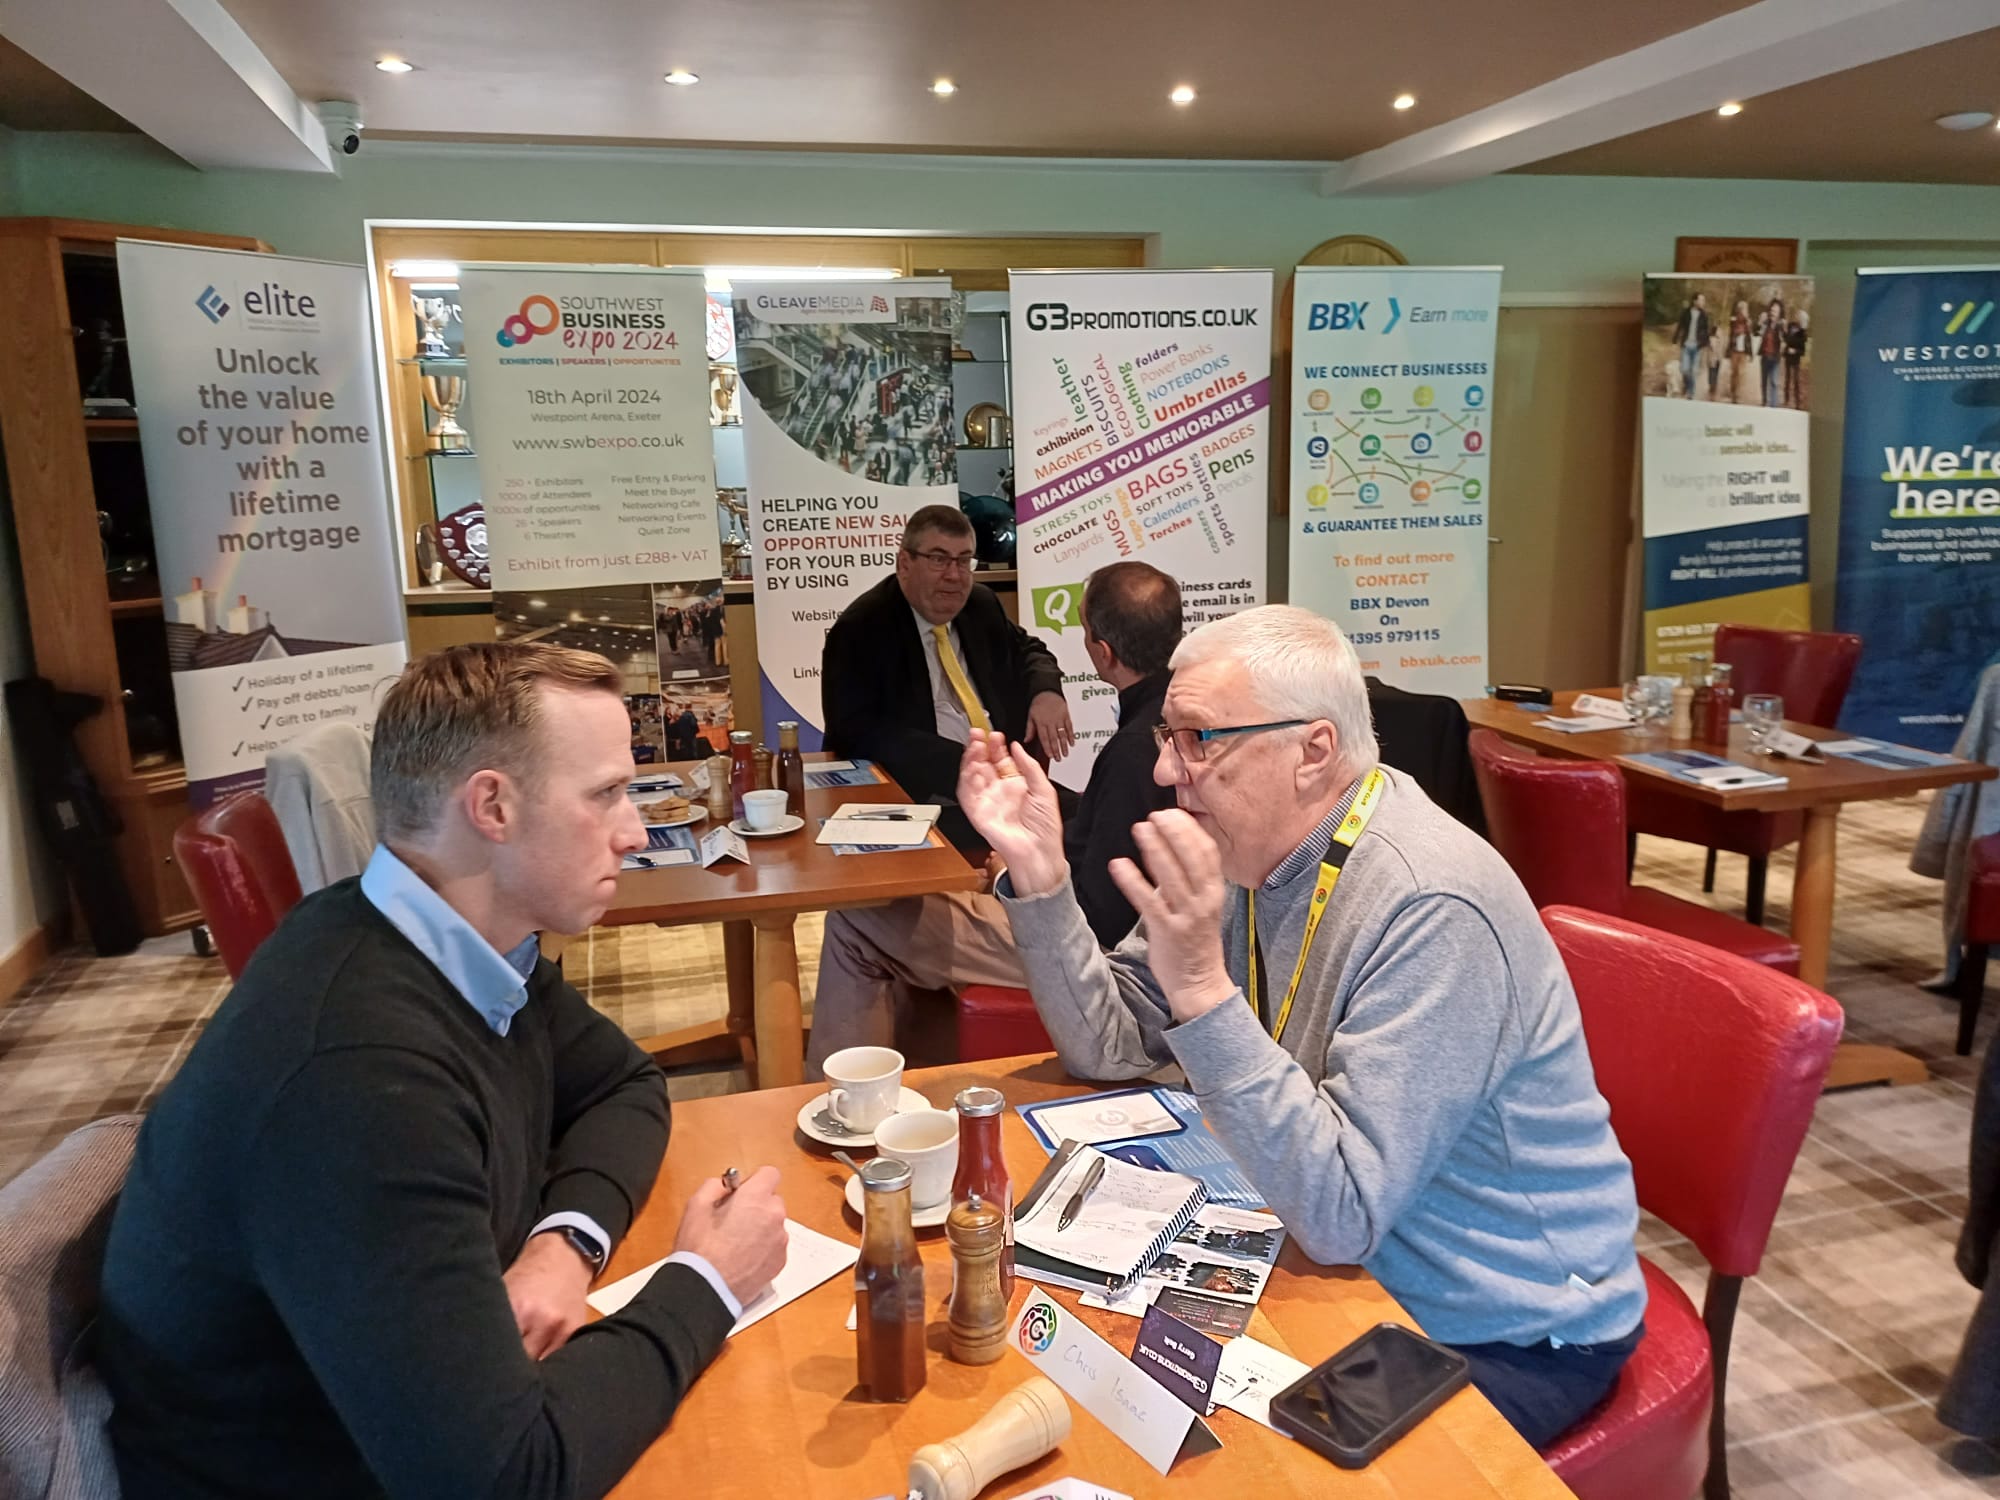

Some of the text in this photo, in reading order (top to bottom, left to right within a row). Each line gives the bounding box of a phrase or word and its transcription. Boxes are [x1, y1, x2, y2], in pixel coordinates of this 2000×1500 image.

[244, 282, 316, 318] elite
[560, 296, 663, 311] SOUTHWEST
[562, 313, 666, 329] BUSINESS
[1308, 302, 1370, 331] BBX
[1410, 307, 1489, 323] Earn more
[563, 329, 679, 356] expo 2024
[216, 348, 320, 376] Unlock
[500, 358, 681, 366] EXHIBITORS SPEAKERS OPPORTUNITIES
[1135, 342, 1179, 368] folders
[1140, 344, 1214, 385] Power Banks
[1146, 354, 1230, 401] NOTEBOOKS
[1304, 363, 1488, 378] WE CONNECT BUSINESSES
[199, 384, 335, 410] the value
[527, 389, 662, 406] 18th April 2024
[1052, 357, 1088, 422] leather
[1093, 353, 1135, 439] ECOLOGICAL
[1117, 361, 1151, 430] Clothing
[1154, 370, 1248, 422] Umbrellas
[531, 412, 662, 423] Westpoint Arena, Exeter
[1081, 374, 1119, 446] BISCUITS
[177, 420, 371, 450] of your home
[512, 433, 684, 450] www.swbexpo.co.uk
[1036, 424, 1095, 457] exhibition
[1201, 423, 1256, 458] BADGES
[1031, 394, 1256, 511] MAKING YOU MEMORABLE
[1034, 438, 1103, 480] MAGNETS
[236, 455, 326, 481] with a
[1208, 448, 1255, 480] Pens
[535, 477, 584, 487] Exhibitors
[611, 473, 707, 485] Free Entry & Parking
[1127, 457, 1189, 500] BAGS
[1727, 470, 1790, 485] RIGHT will
[530, 490, 592, 501] of Attendees
[624, 487, 696, 498] Meet the Buyer
[1135, 482, 1194, 515] SOFT TOYS
[1189, 452, 1236, 547] sports bottles
[1729, 492, 1775, 506] brilliant
[1896, 482, 2000, 515] here
[229, 489, 341, 517] lifetime
[523, 503, 601, 515] of opportunities
[622, 500, 679, 511] Networking
[762, 495, 878, 513] HELPING YOU
[1143, 495, 1200, 529] Calenders
[538, 518, 582, 528] Speakers
[618, 512, 707, 524] Networking Events
[763, 514, 908, 533] CREATE NEW SAL
[1033, 492, 1113, 537] STRESS TOYS
[1303, 514, 1483, 533] & GUARANTEE THEM SALES
[218, 525, 361, 553] mortgage
[533, 531, 576, 541] Theatres
[638, 526, 691, 537] Quiet Zone
[1033, 517, 1099, 554] CHOCOLATE
[1103, 509, 1132, 557] MUGS
[1149, 517, 1193, 542] Torches
[764, 533, 903, 551] OPPORTUNITIES
[1054, 532, 1105, 563] Lanyards
[508, 557, 561, 572] Exhibit
[564, 554, 600, 569] from
[602, 553, 631, 569] just
[681, 549, 709, 562] VAT
[766, 552, 898, 571] FOR YOUR BUS
[1333, 552, 1455, 568] To find out more
[767, 574, 849, 590] BY USING
[1217, 578, 1252, 590] cards
[1356, 572, 1430, 588] CONTACT
[1044, 588, 1072, 625] Q
[1192, 595, 1227, 607] email
[1230, 593, 1241, 605] is
[1243, 593, 1255, 604] in
[1350, 597, 1429, 610] BBX Devon
[1182, 611, 1204, 622] will
[1380, 614, 1399, 625] On
[1345, 629, 1440, 644] 1395 979115
[1400, 654, 1482, 668] bbxuk.com
[248, 662, 374, 690] Holiday of a lifetime
[793, 667, 822, 679] Link
[257, 698, 279, 709] Pay
[283, 693, 301, 705] off
[1081, 686, 1116, 700] givea
[276, 705, 358, 727] Gift to family
[248, 739, 277, 753] Help
[1063, 1344, 1096, 1381] Chris
